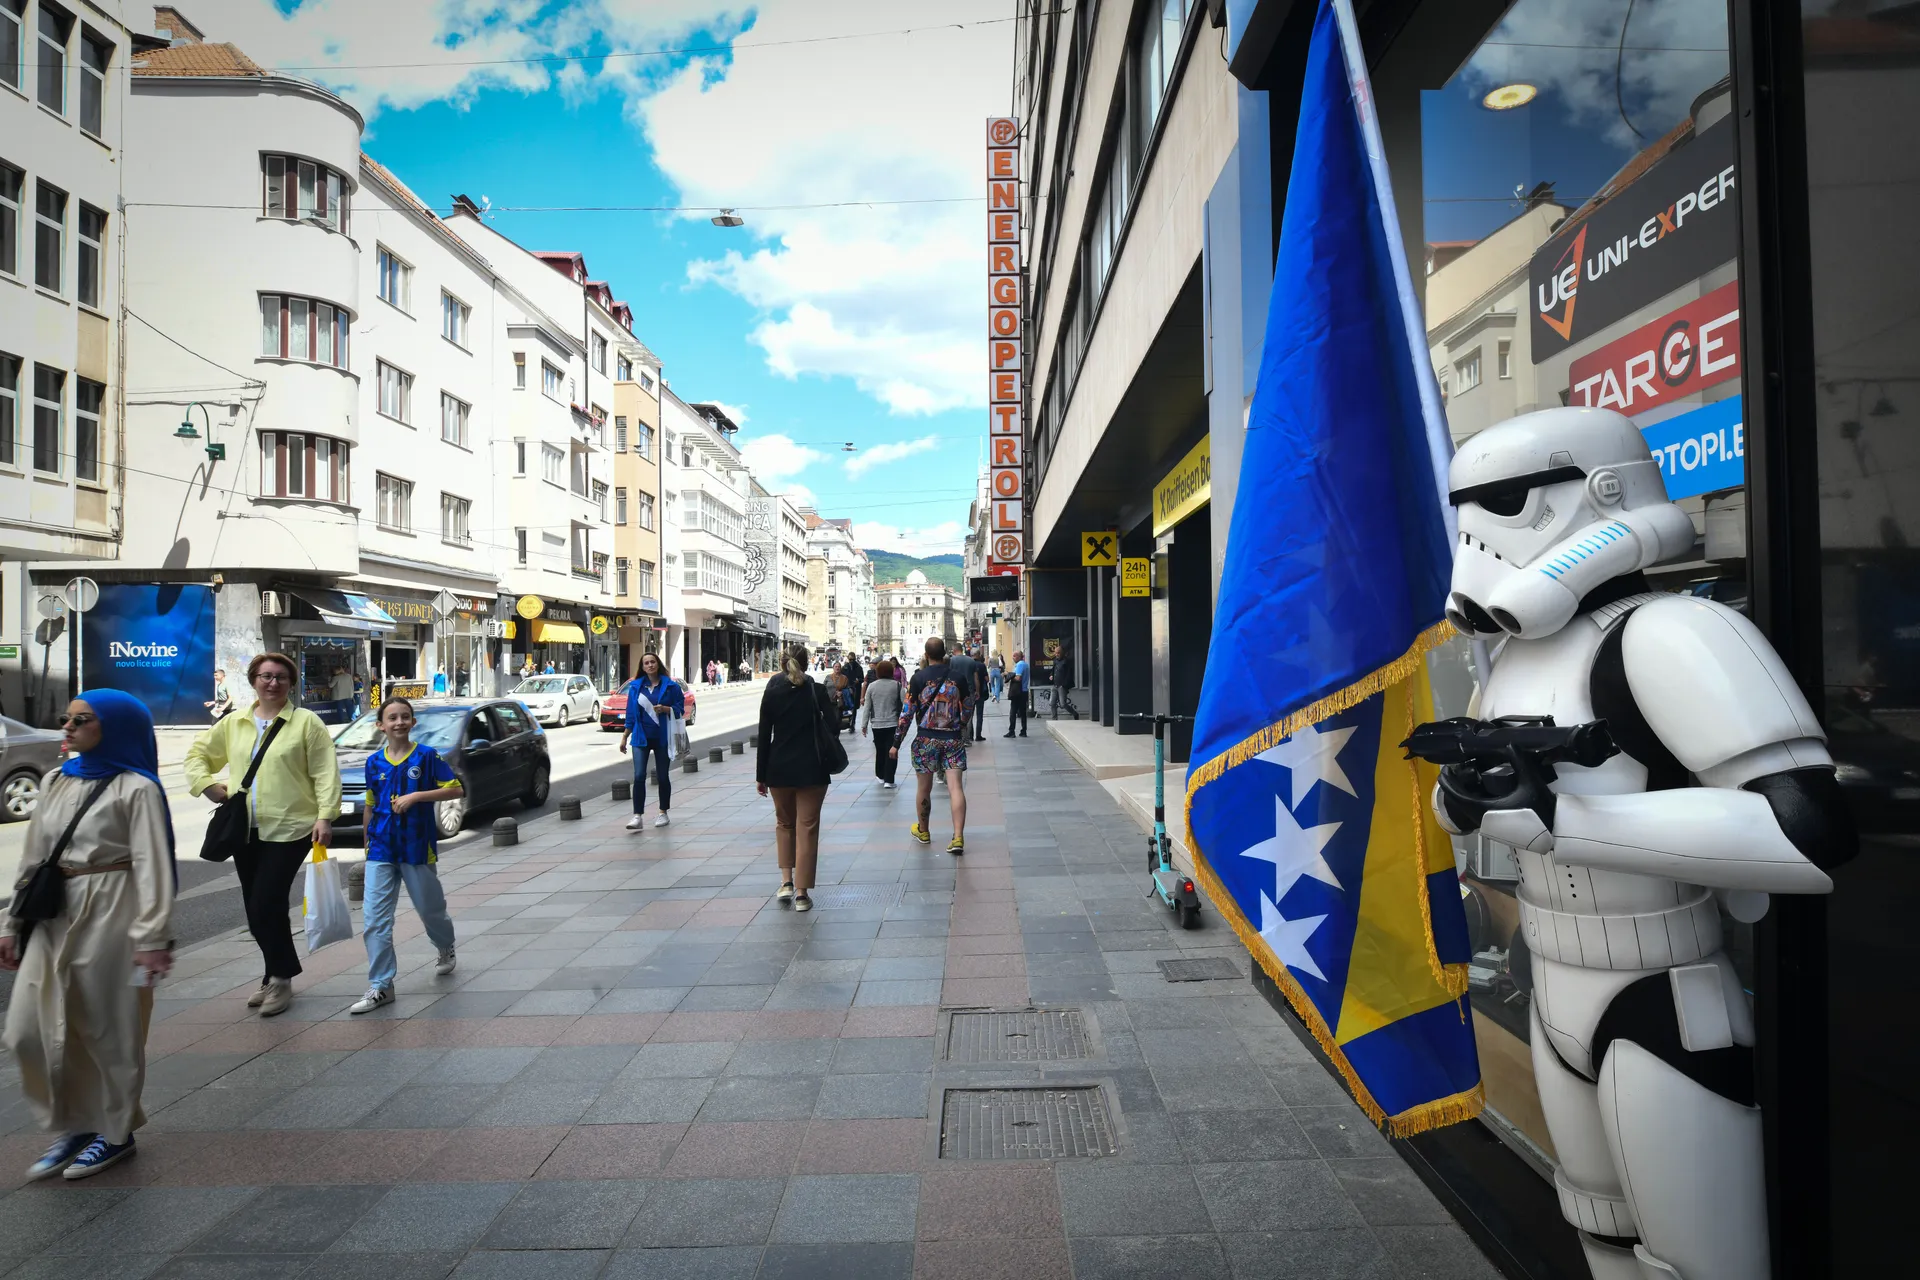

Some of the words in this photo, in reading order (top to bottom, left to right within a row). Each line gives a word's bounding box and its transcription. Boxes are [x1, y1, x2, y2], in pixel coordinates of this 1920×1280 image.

[1538, 262, 1577, 313] UE
[993, 151, 1018, 528] ENERGOPETROL
[1166, 466, 1200, 514] Raiffeisen
[1125, 562, 1146, 571] 24h
[473, 600, 488, 612] DIVA
[549, 609, 571, 621] PEKARA
[109, 641, 178, 657] iNovine
[136, 659, 151, 668] lice
[151, 659, 172, 668] ulice
